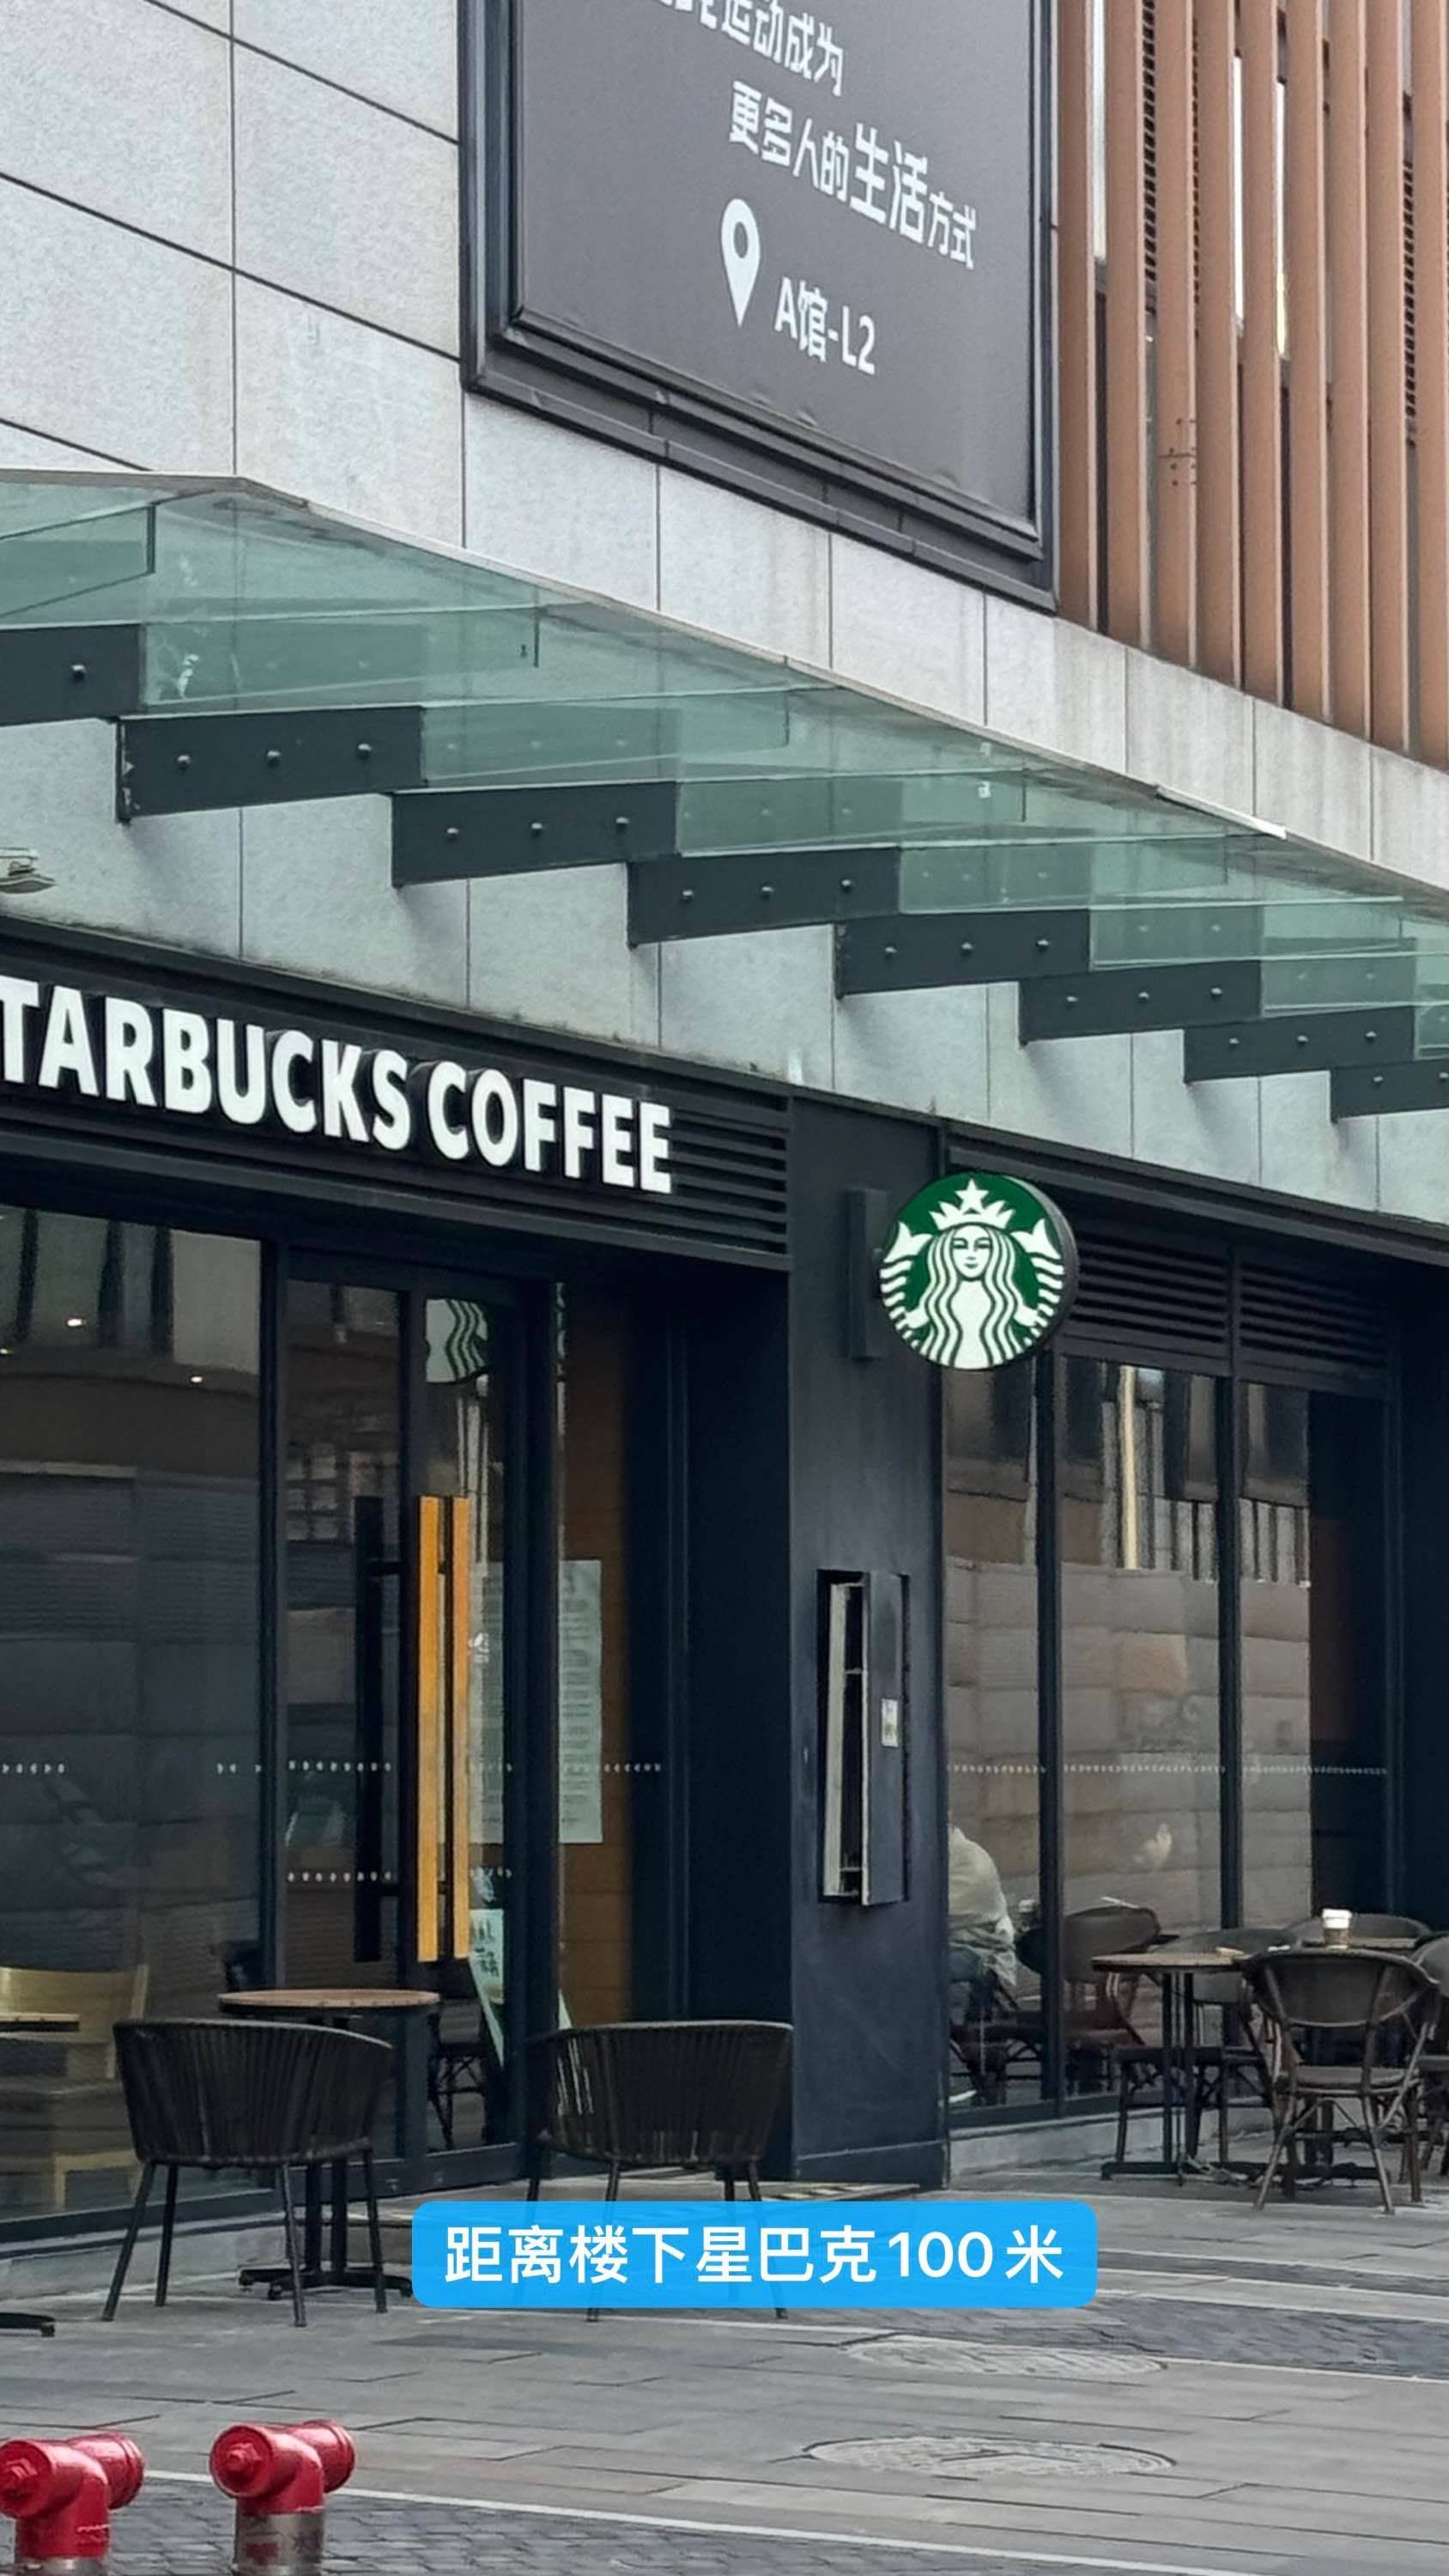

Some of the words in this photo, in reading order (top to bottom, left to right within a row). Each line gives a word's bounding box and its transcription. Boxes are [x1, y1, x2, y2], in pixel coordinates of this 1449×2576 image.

[730, 81, 976, 270] 更多人的生活方式
[774, 276, 876, 375] A馆-L2
[428, 1061, 672, 1194] COFFEE
